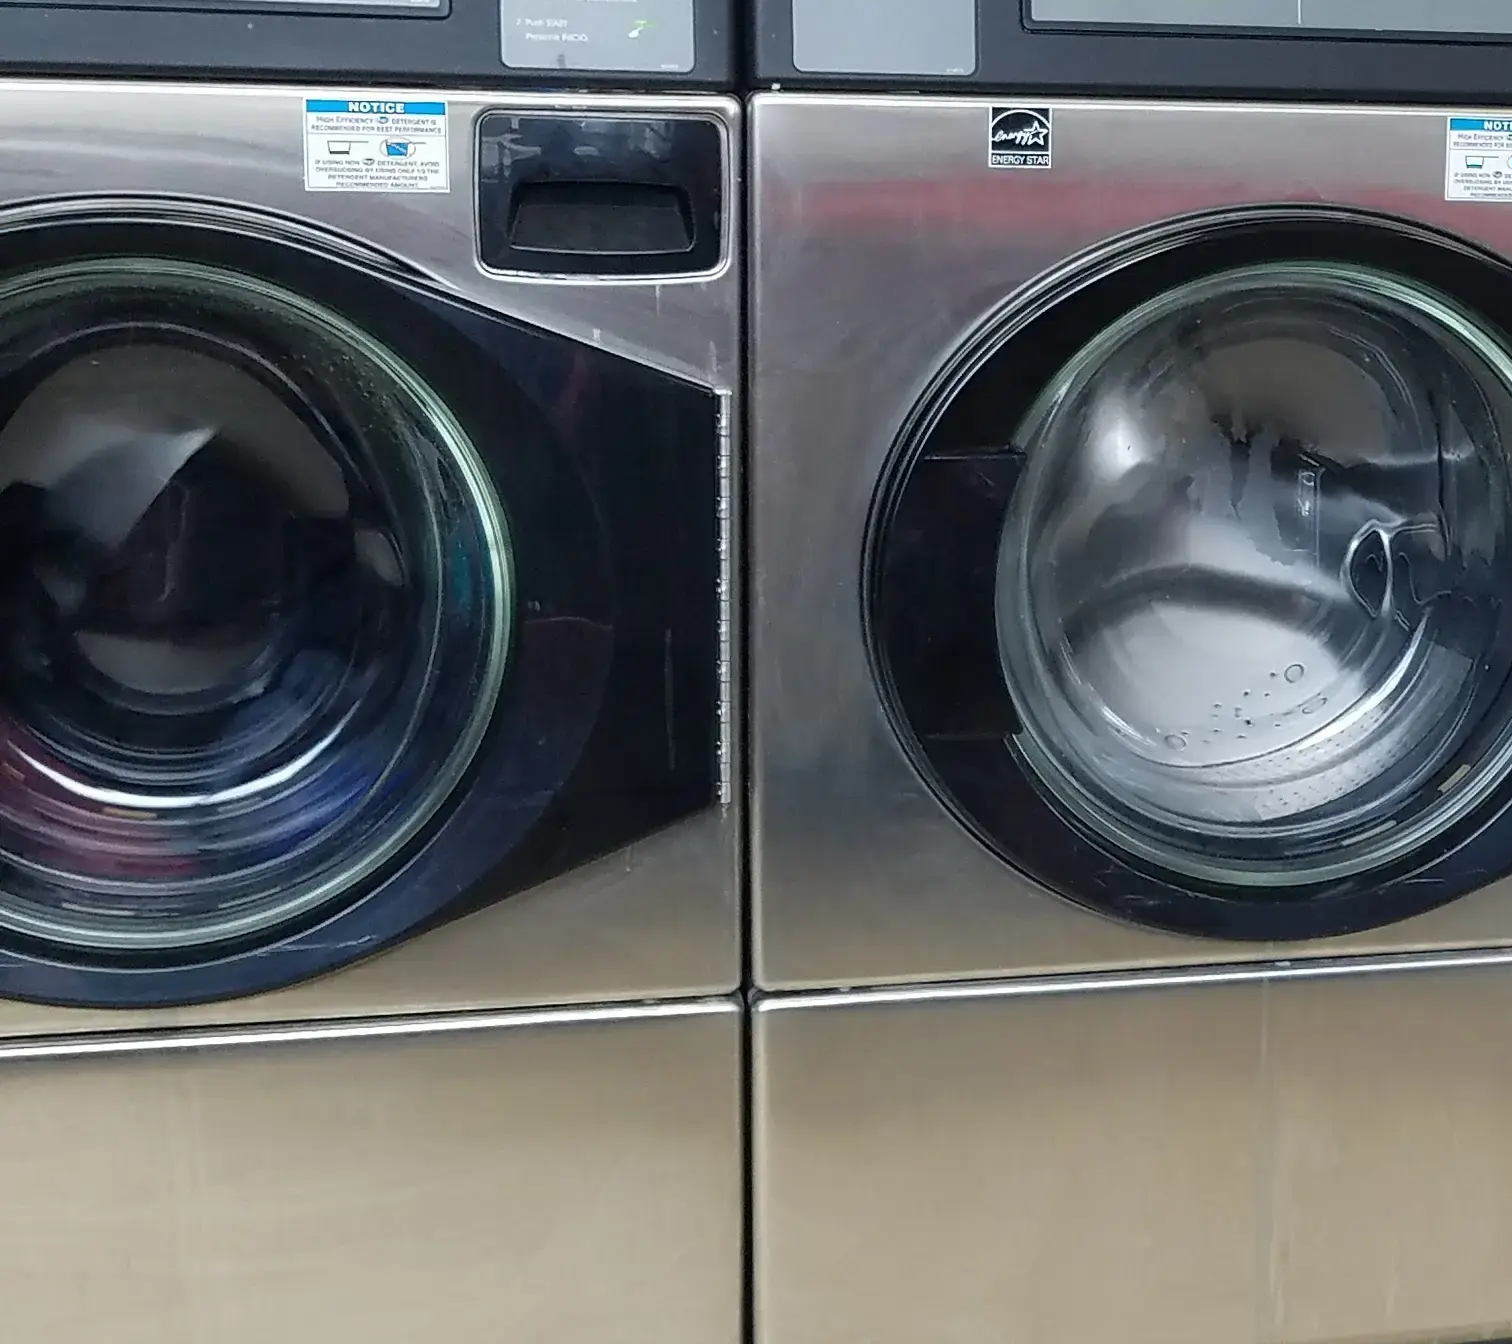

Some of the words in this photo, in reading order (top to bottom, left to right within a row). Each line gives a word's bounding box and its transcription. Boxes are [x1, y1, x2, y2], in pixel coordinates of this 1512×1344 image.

[348, 101, 405, 114] NOTICE
[992, 155, 1026, 164] ENERGY
[1026, 155, 1049, 165] STAR
